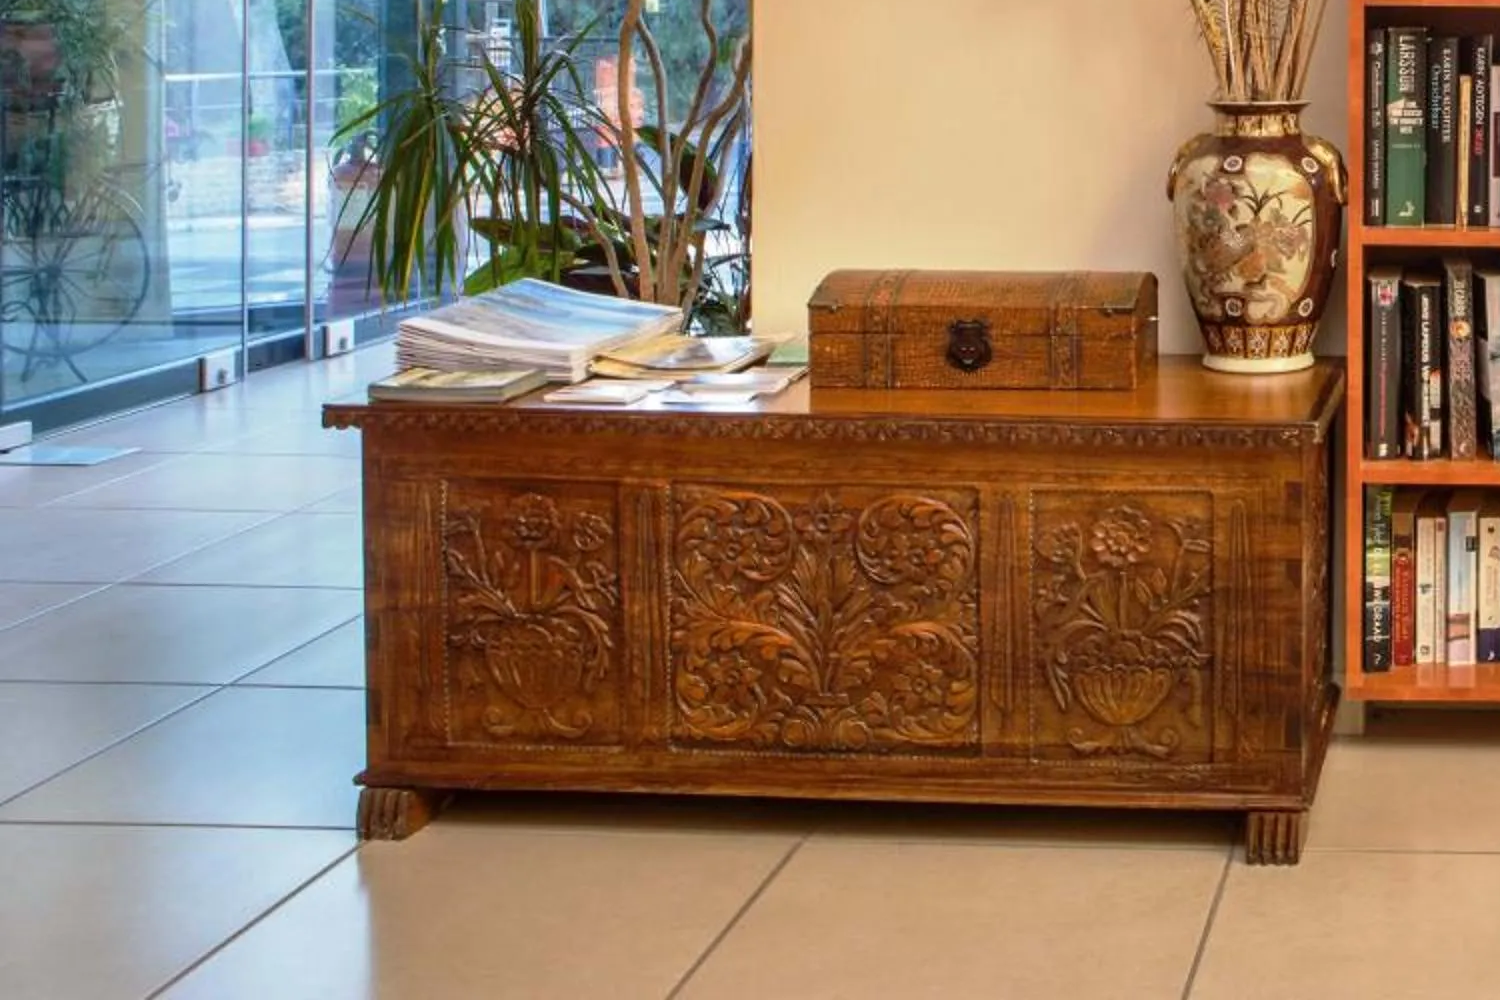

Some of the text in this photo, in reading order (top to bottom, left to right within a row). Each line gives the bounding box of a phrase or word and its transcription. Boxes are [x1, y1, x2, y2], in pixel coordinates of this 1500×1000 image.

[1399, 34, 1416, 94] LARSSON
[1442, 48, 1452, 143] KARIN SLAUGHTER
